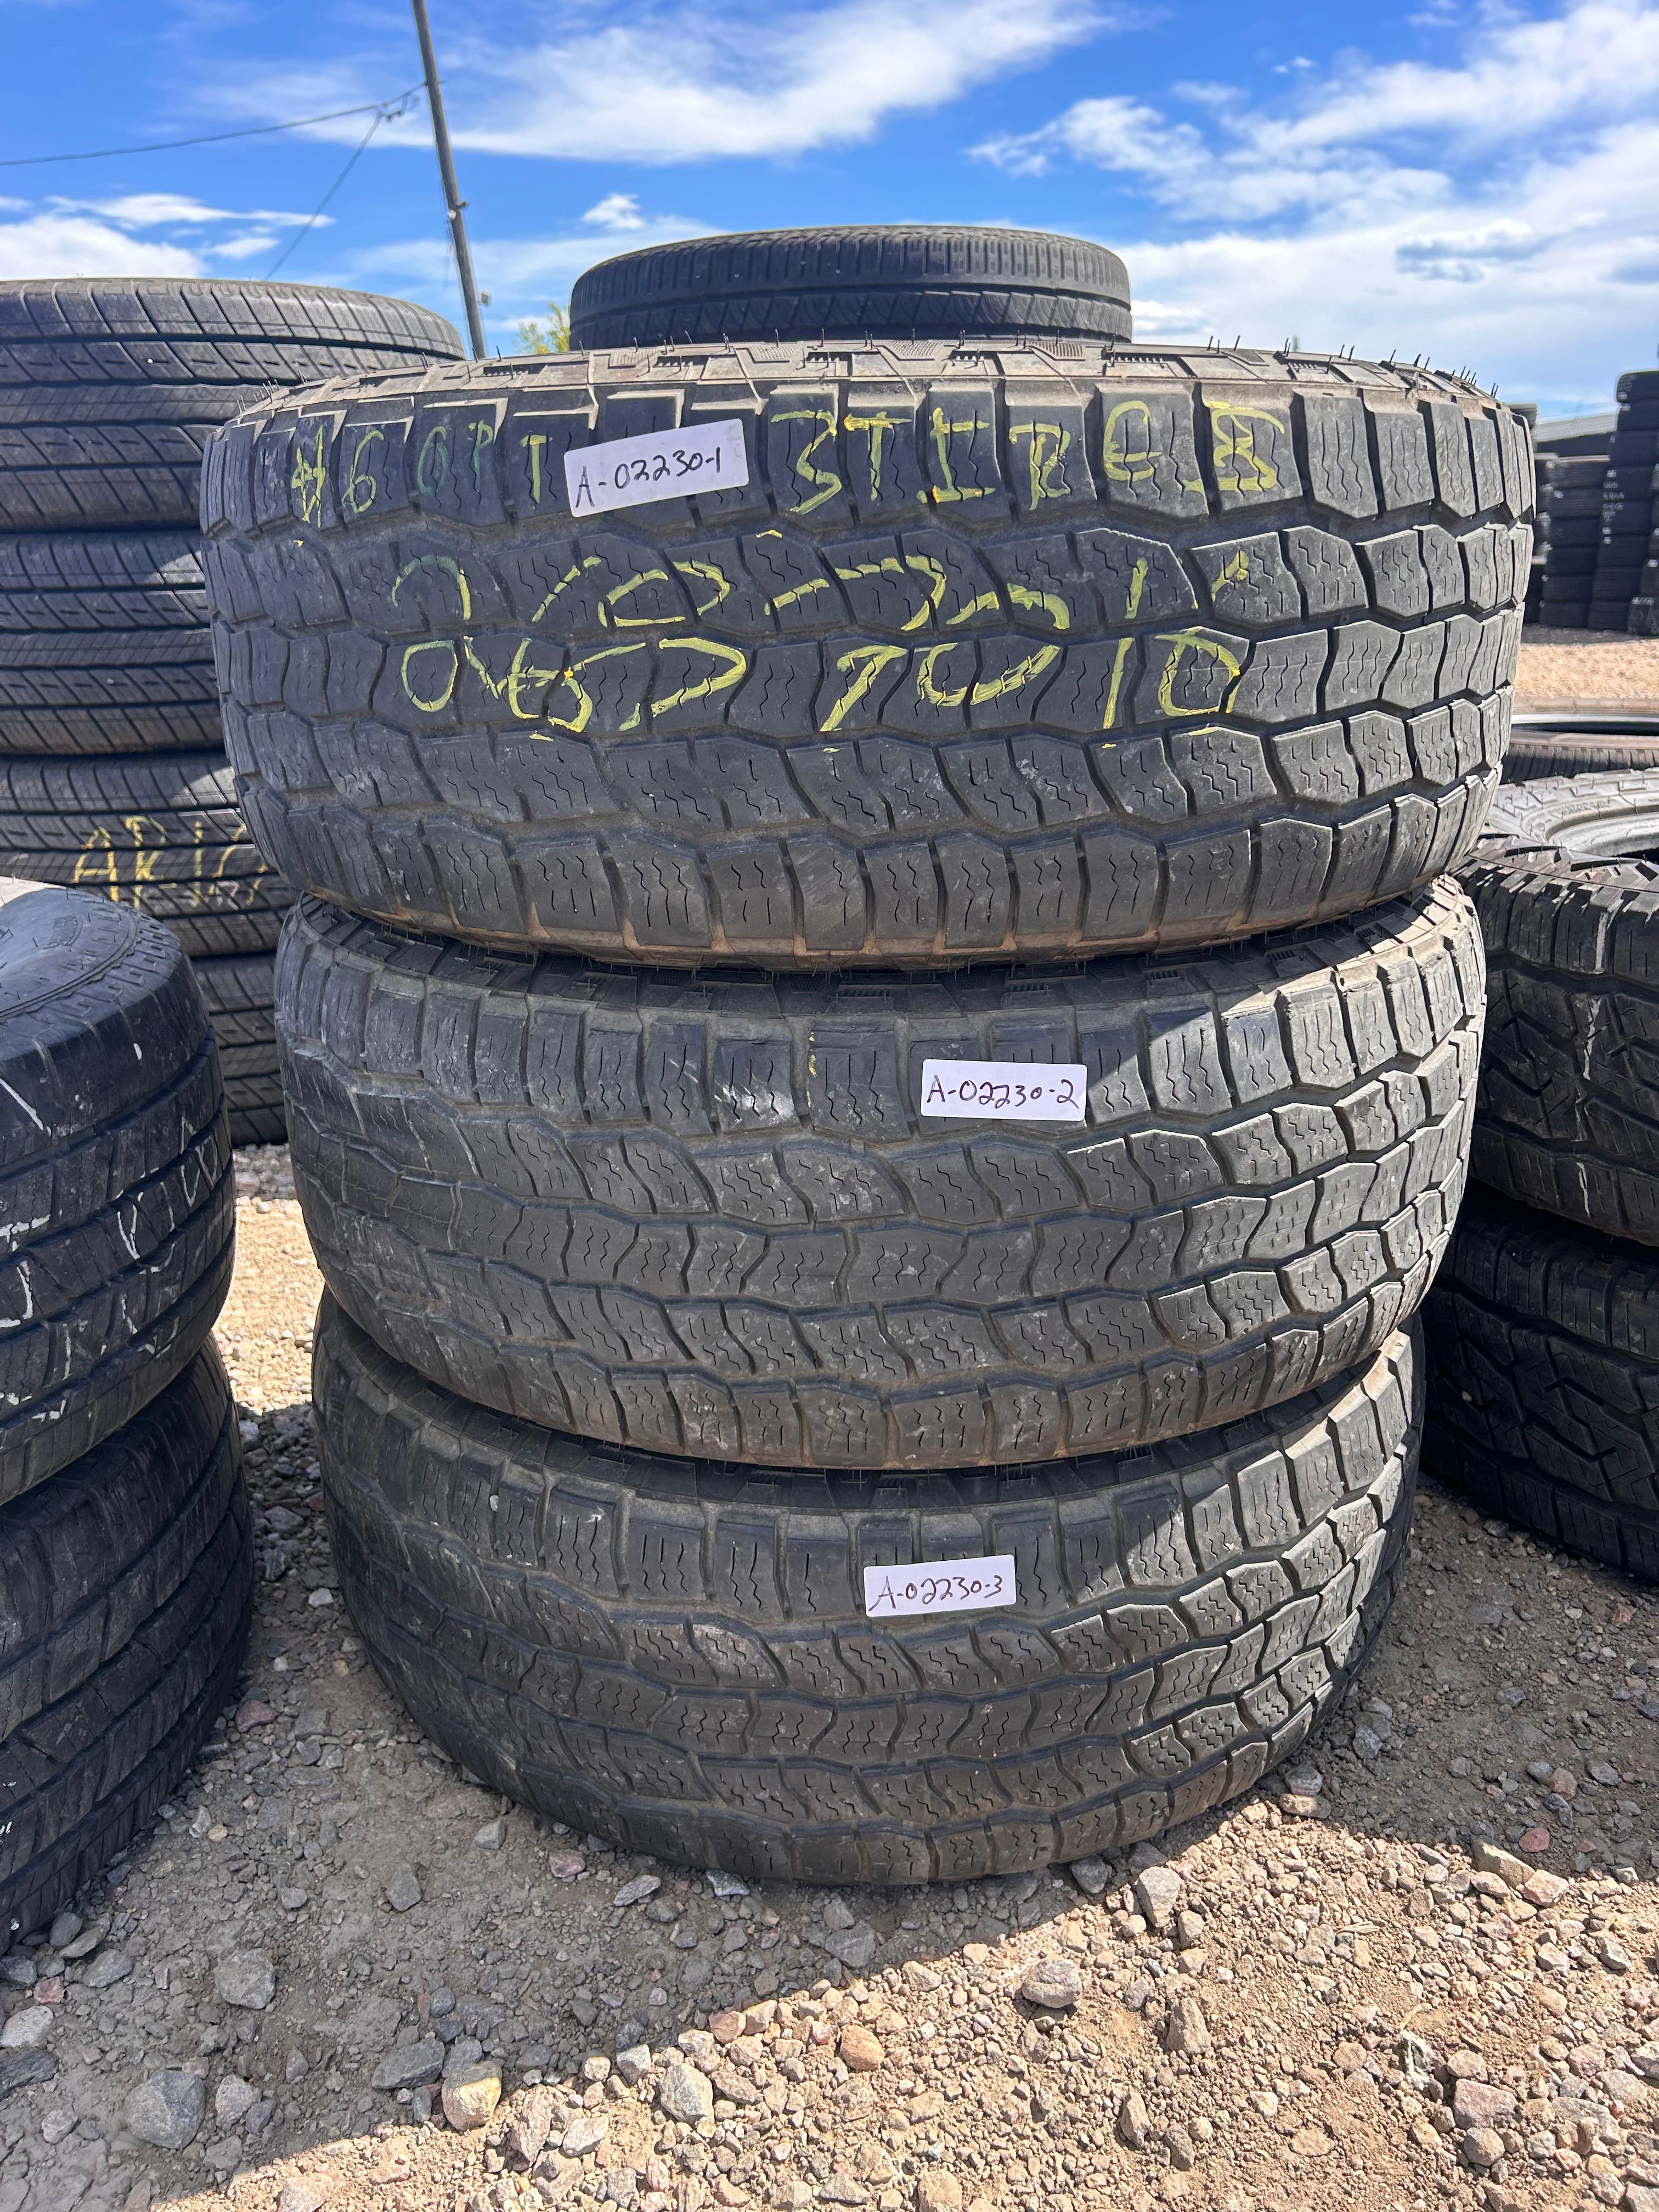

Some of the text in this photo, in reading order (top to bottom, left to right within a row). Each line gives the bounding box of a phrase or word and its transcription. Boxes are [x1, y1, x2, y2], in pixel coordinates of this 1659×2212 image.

[575, 447, 720, 508] A-02230-1
[926, 1074, 1080, 1109] A-02230-2
[868, 1575, 1002, 1612] A-02230-3
